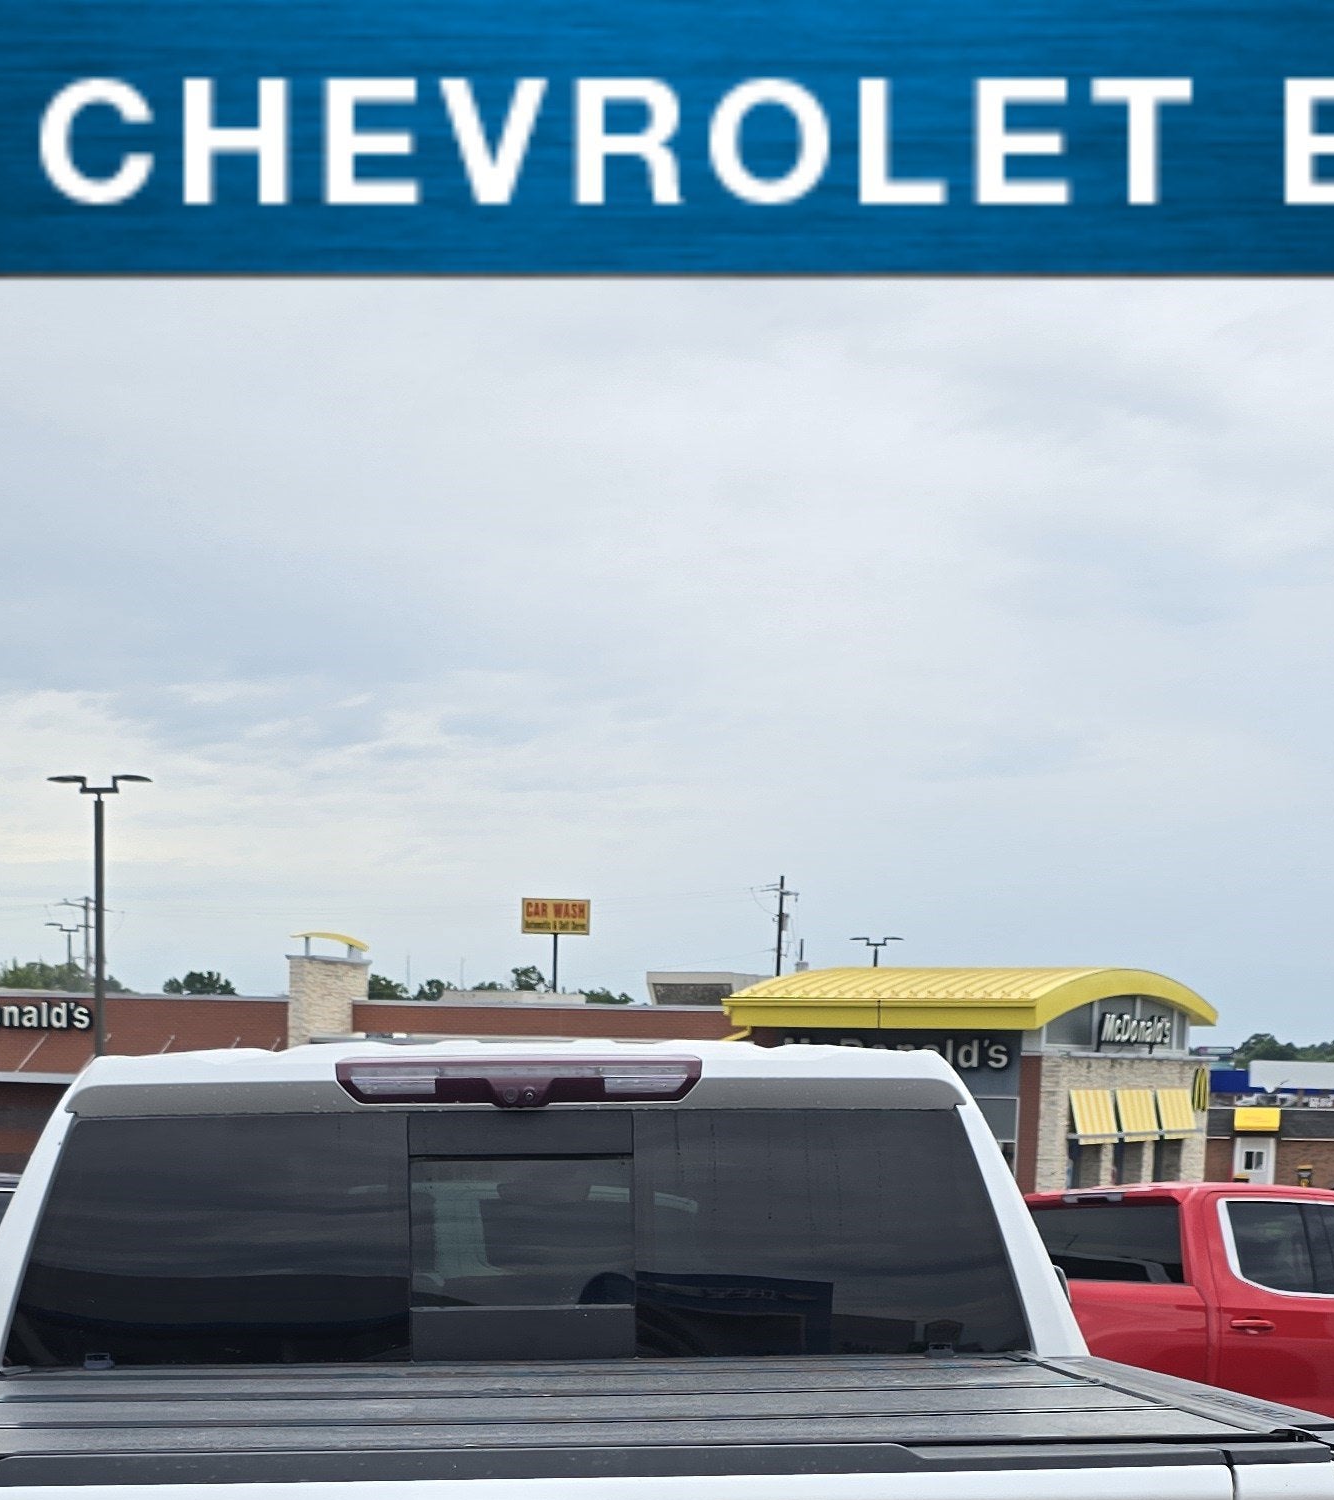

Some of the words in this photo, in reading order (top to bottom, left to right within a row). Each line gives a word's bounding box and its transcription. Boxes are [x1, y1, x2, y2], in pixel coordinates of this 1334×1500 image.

[525, 902, 548, 918] CAR
[553, 903, 586, 919] WASH
[1100, 1013, 1171, 1043] McDonald's
